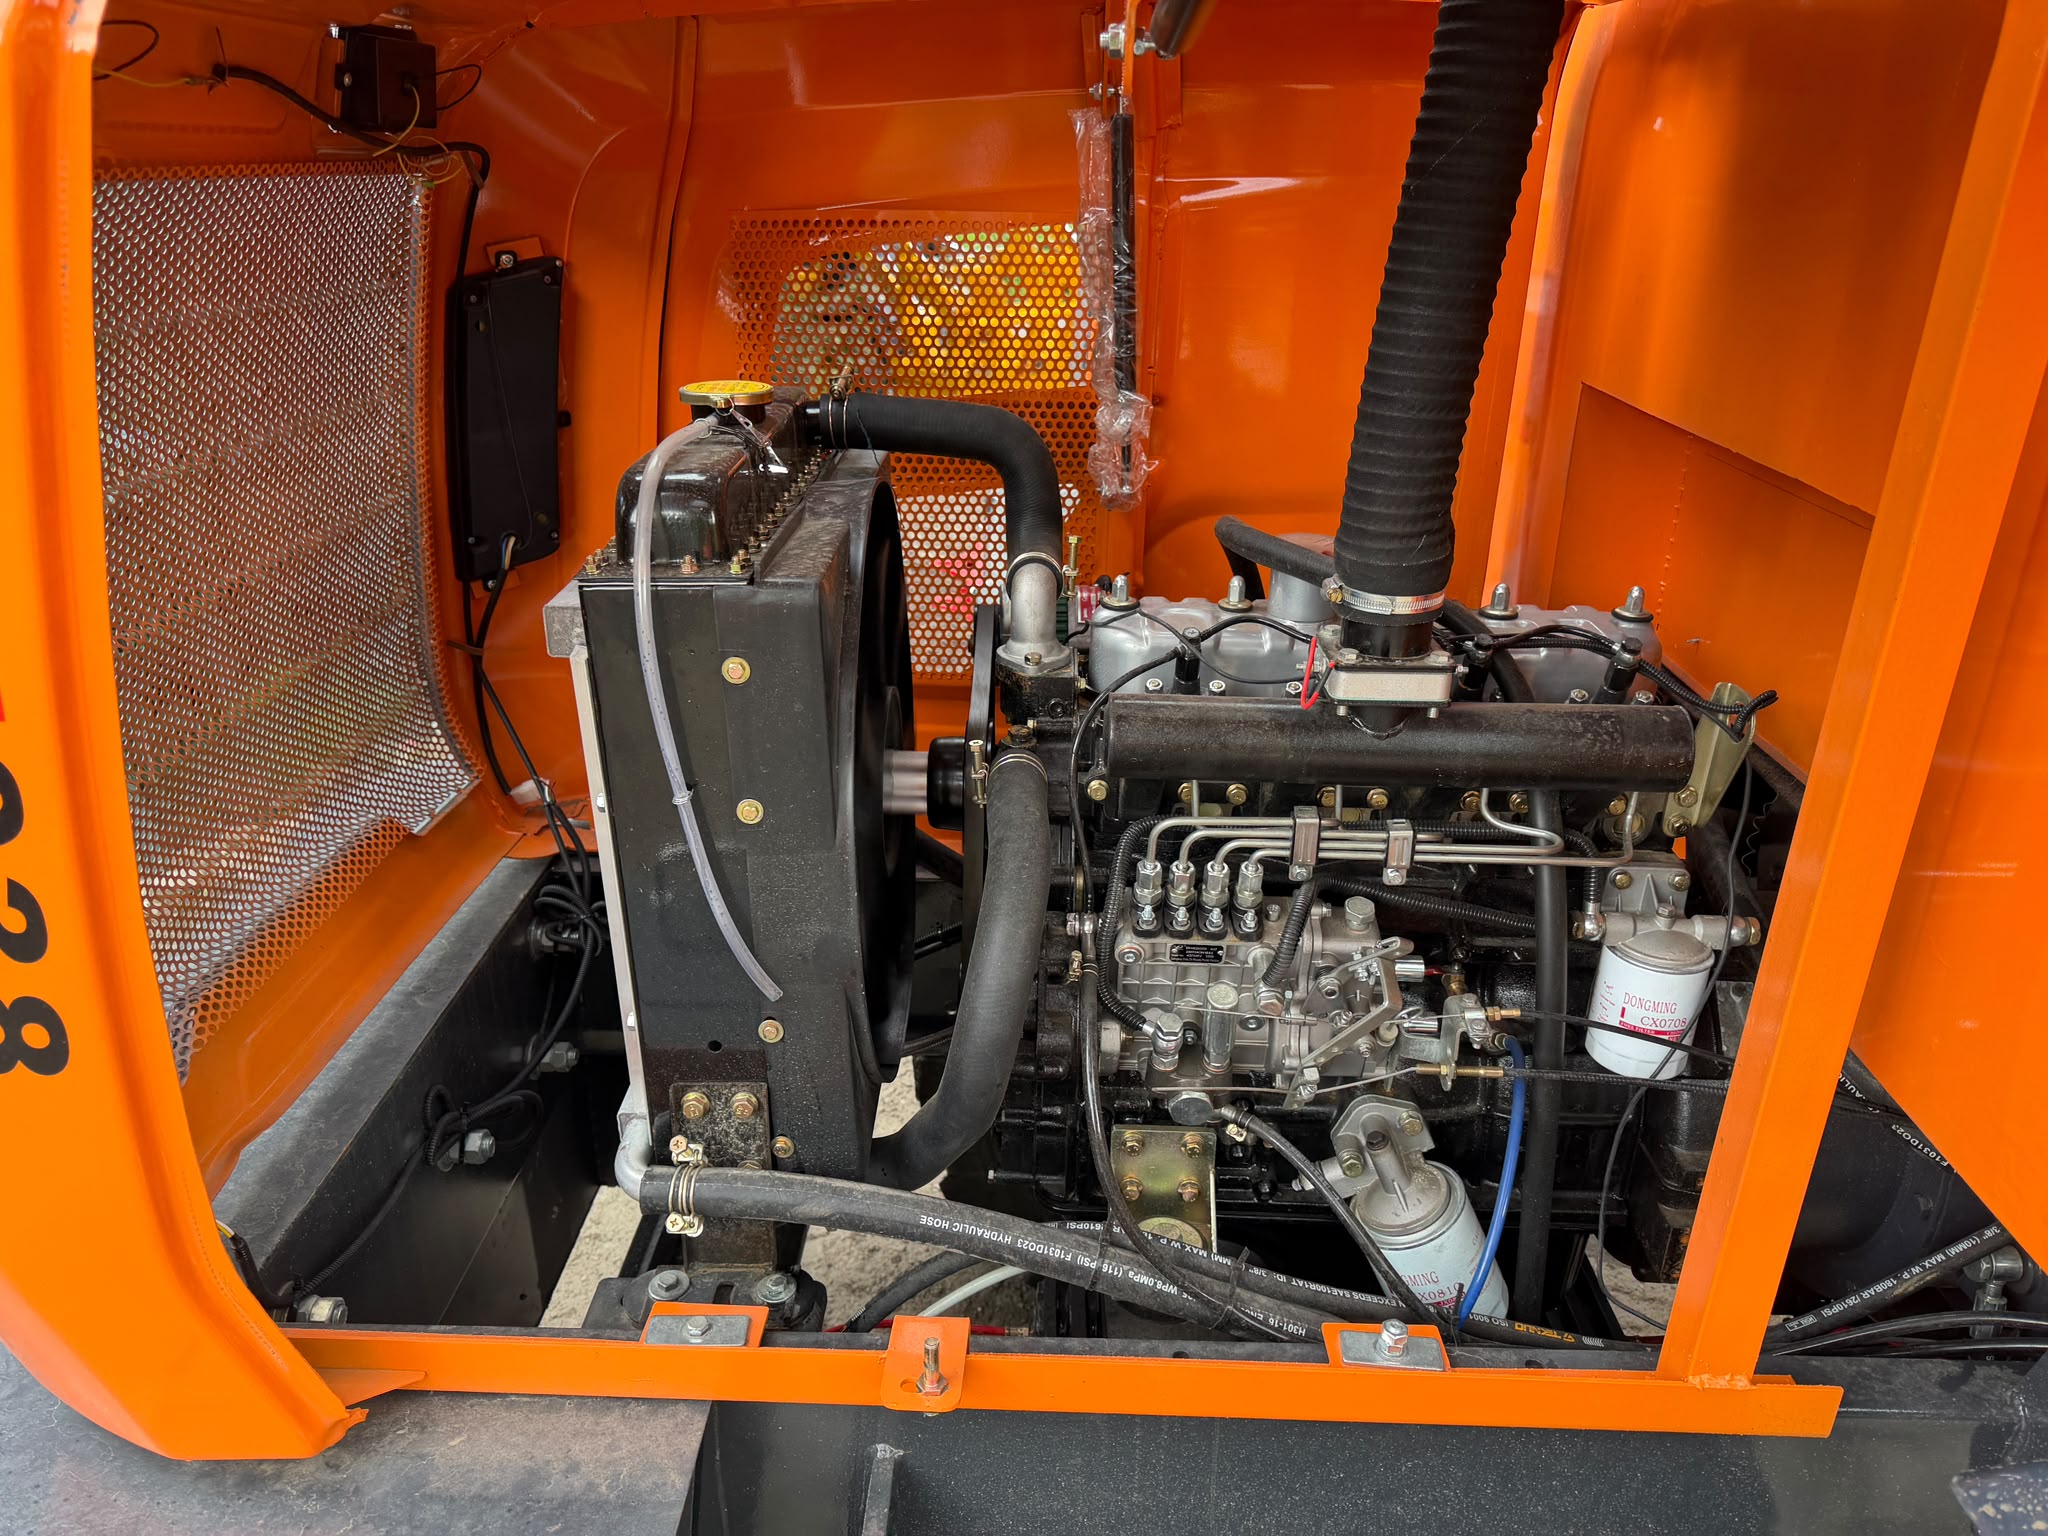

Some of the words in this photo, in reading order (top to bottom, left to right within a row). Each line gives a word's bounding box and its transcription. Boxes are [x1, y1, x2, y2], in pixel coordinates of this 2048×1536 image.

[1624, 993, 1677, 1014] DONGMING
[919, 1215, 949, 1228] HOSE
[952, 1222, 1011, 1245] HYDRAULIC
[1946, 1236, 1980, 1258] (10MM)
[1076, 1254, 1097, 1270] PSI)
[1101, 1263, 1122, 1278] (116
[1128, 1271, 1178, 1295] WP8.0MPa
[1290, 1278, 1351, 1298] SAE100R1AT
[1860, 1278, 1897, 1299] 180BAR
[1352, 1292, 1397, 1307] EXCEEDS
[1469, 1313, 1490, 1323] 9001
[1492, 1316, 1509, 1327] ISO
